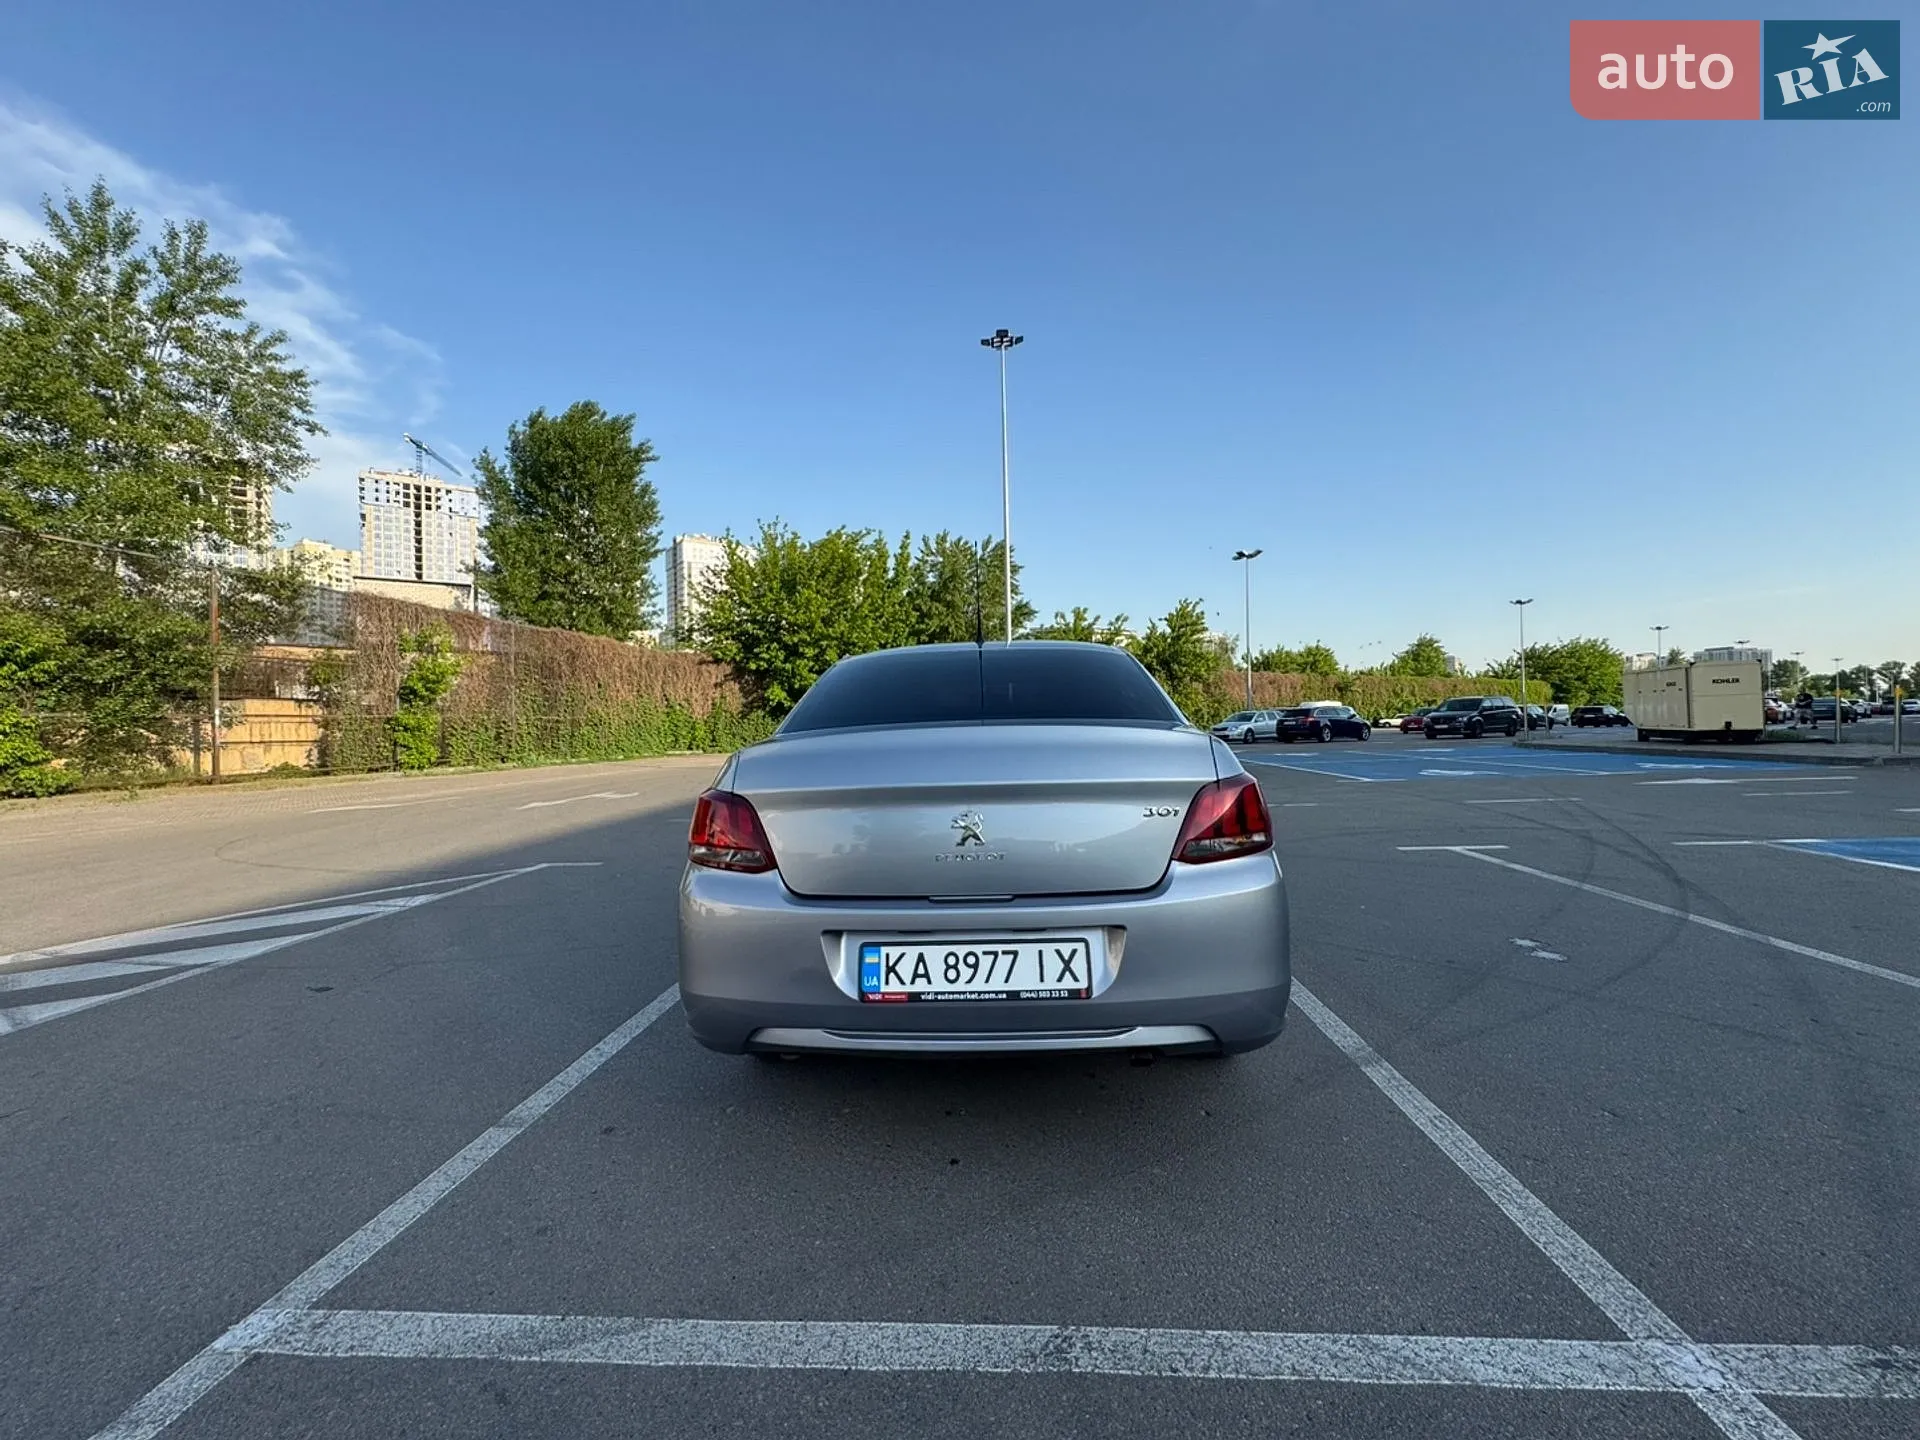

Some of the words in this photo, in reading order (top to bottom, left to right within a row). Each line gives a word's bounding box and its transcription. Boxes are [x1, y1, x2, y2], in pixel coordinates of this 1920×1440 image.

[1142, 806, 1180, 818] 301
[884, 951, 933, 986] KA
[943, 950, 1020, 984] 8977
[1037, 948, 1081, 984] IX
[864, 976, 878, 986] UA
[920, 991, 1007, 1000] vidi-automarket.com.ua
